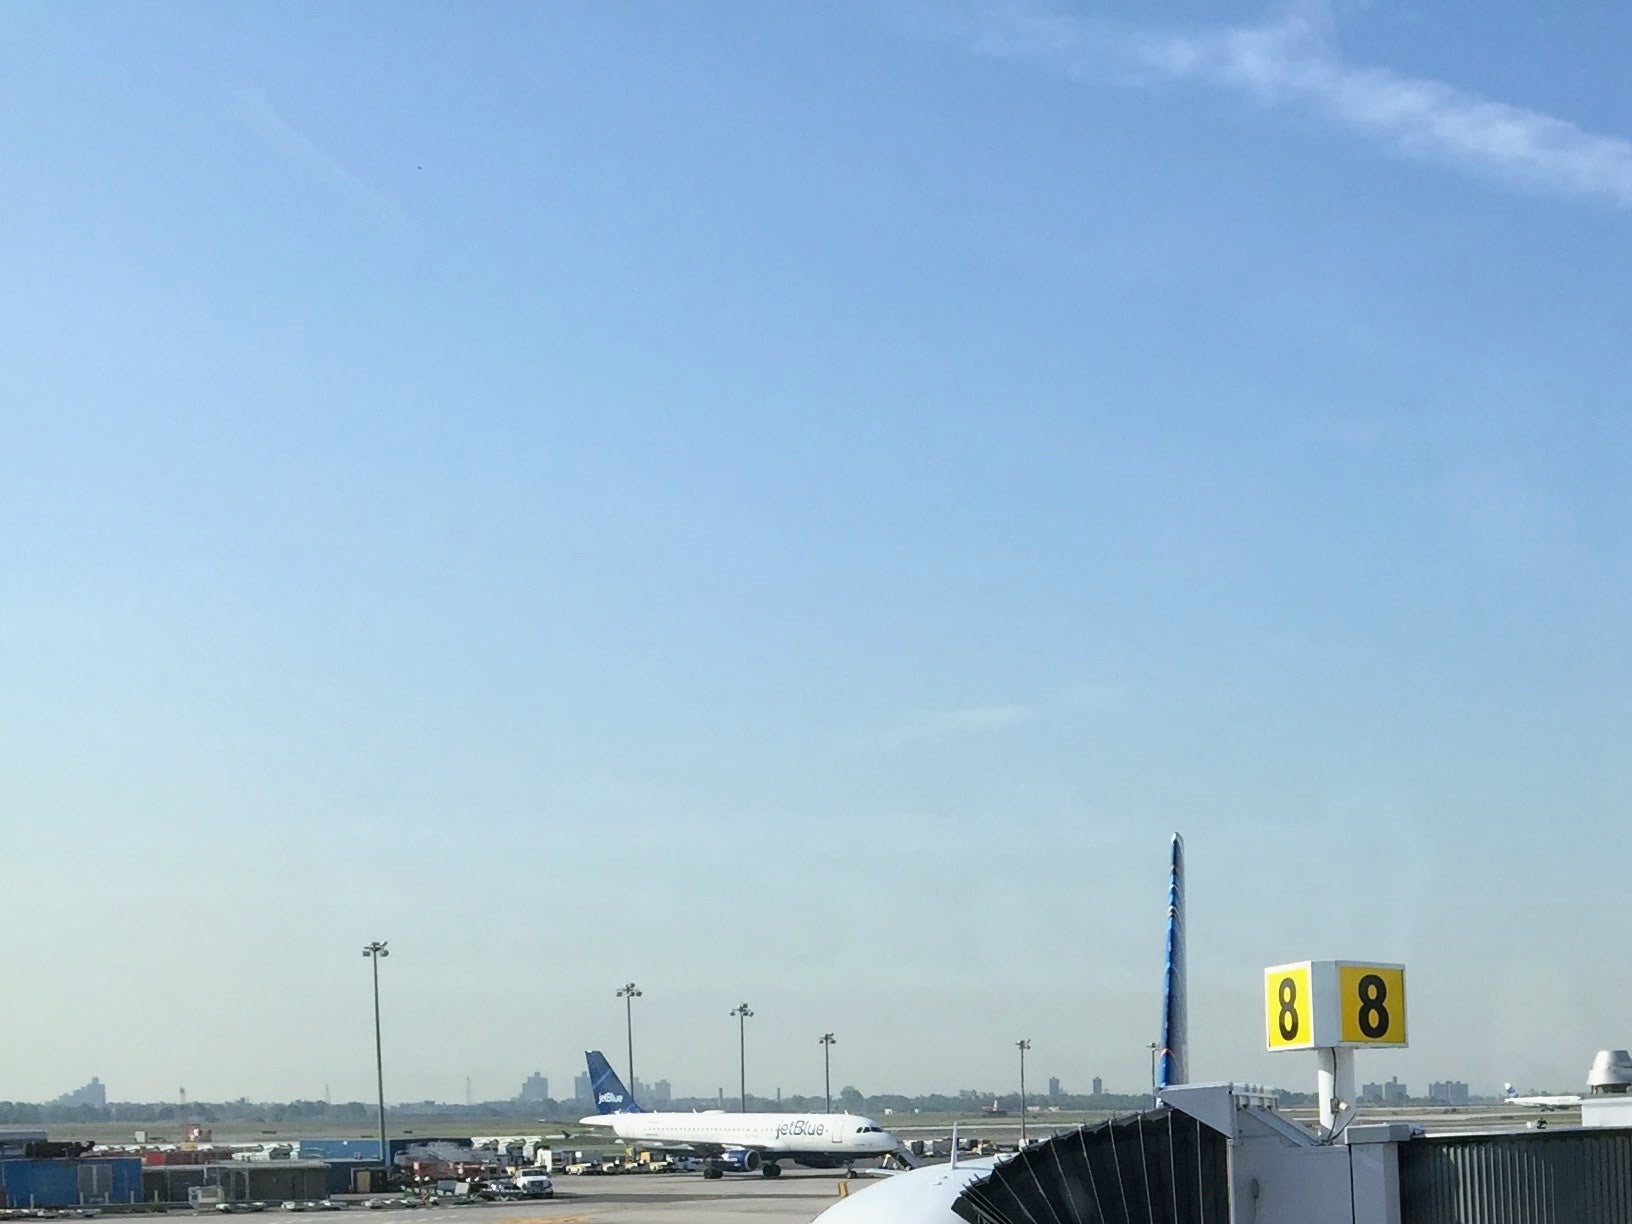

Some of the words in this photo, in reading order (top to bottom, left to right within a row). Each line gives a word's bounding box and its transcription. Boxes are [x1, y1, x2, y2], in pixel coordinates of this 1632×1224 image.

[1279, 977, 1299, 1041] 8
[1358, 974, 1390, 1039] 8
[775, 1120, 825, 1140] jetBlue
